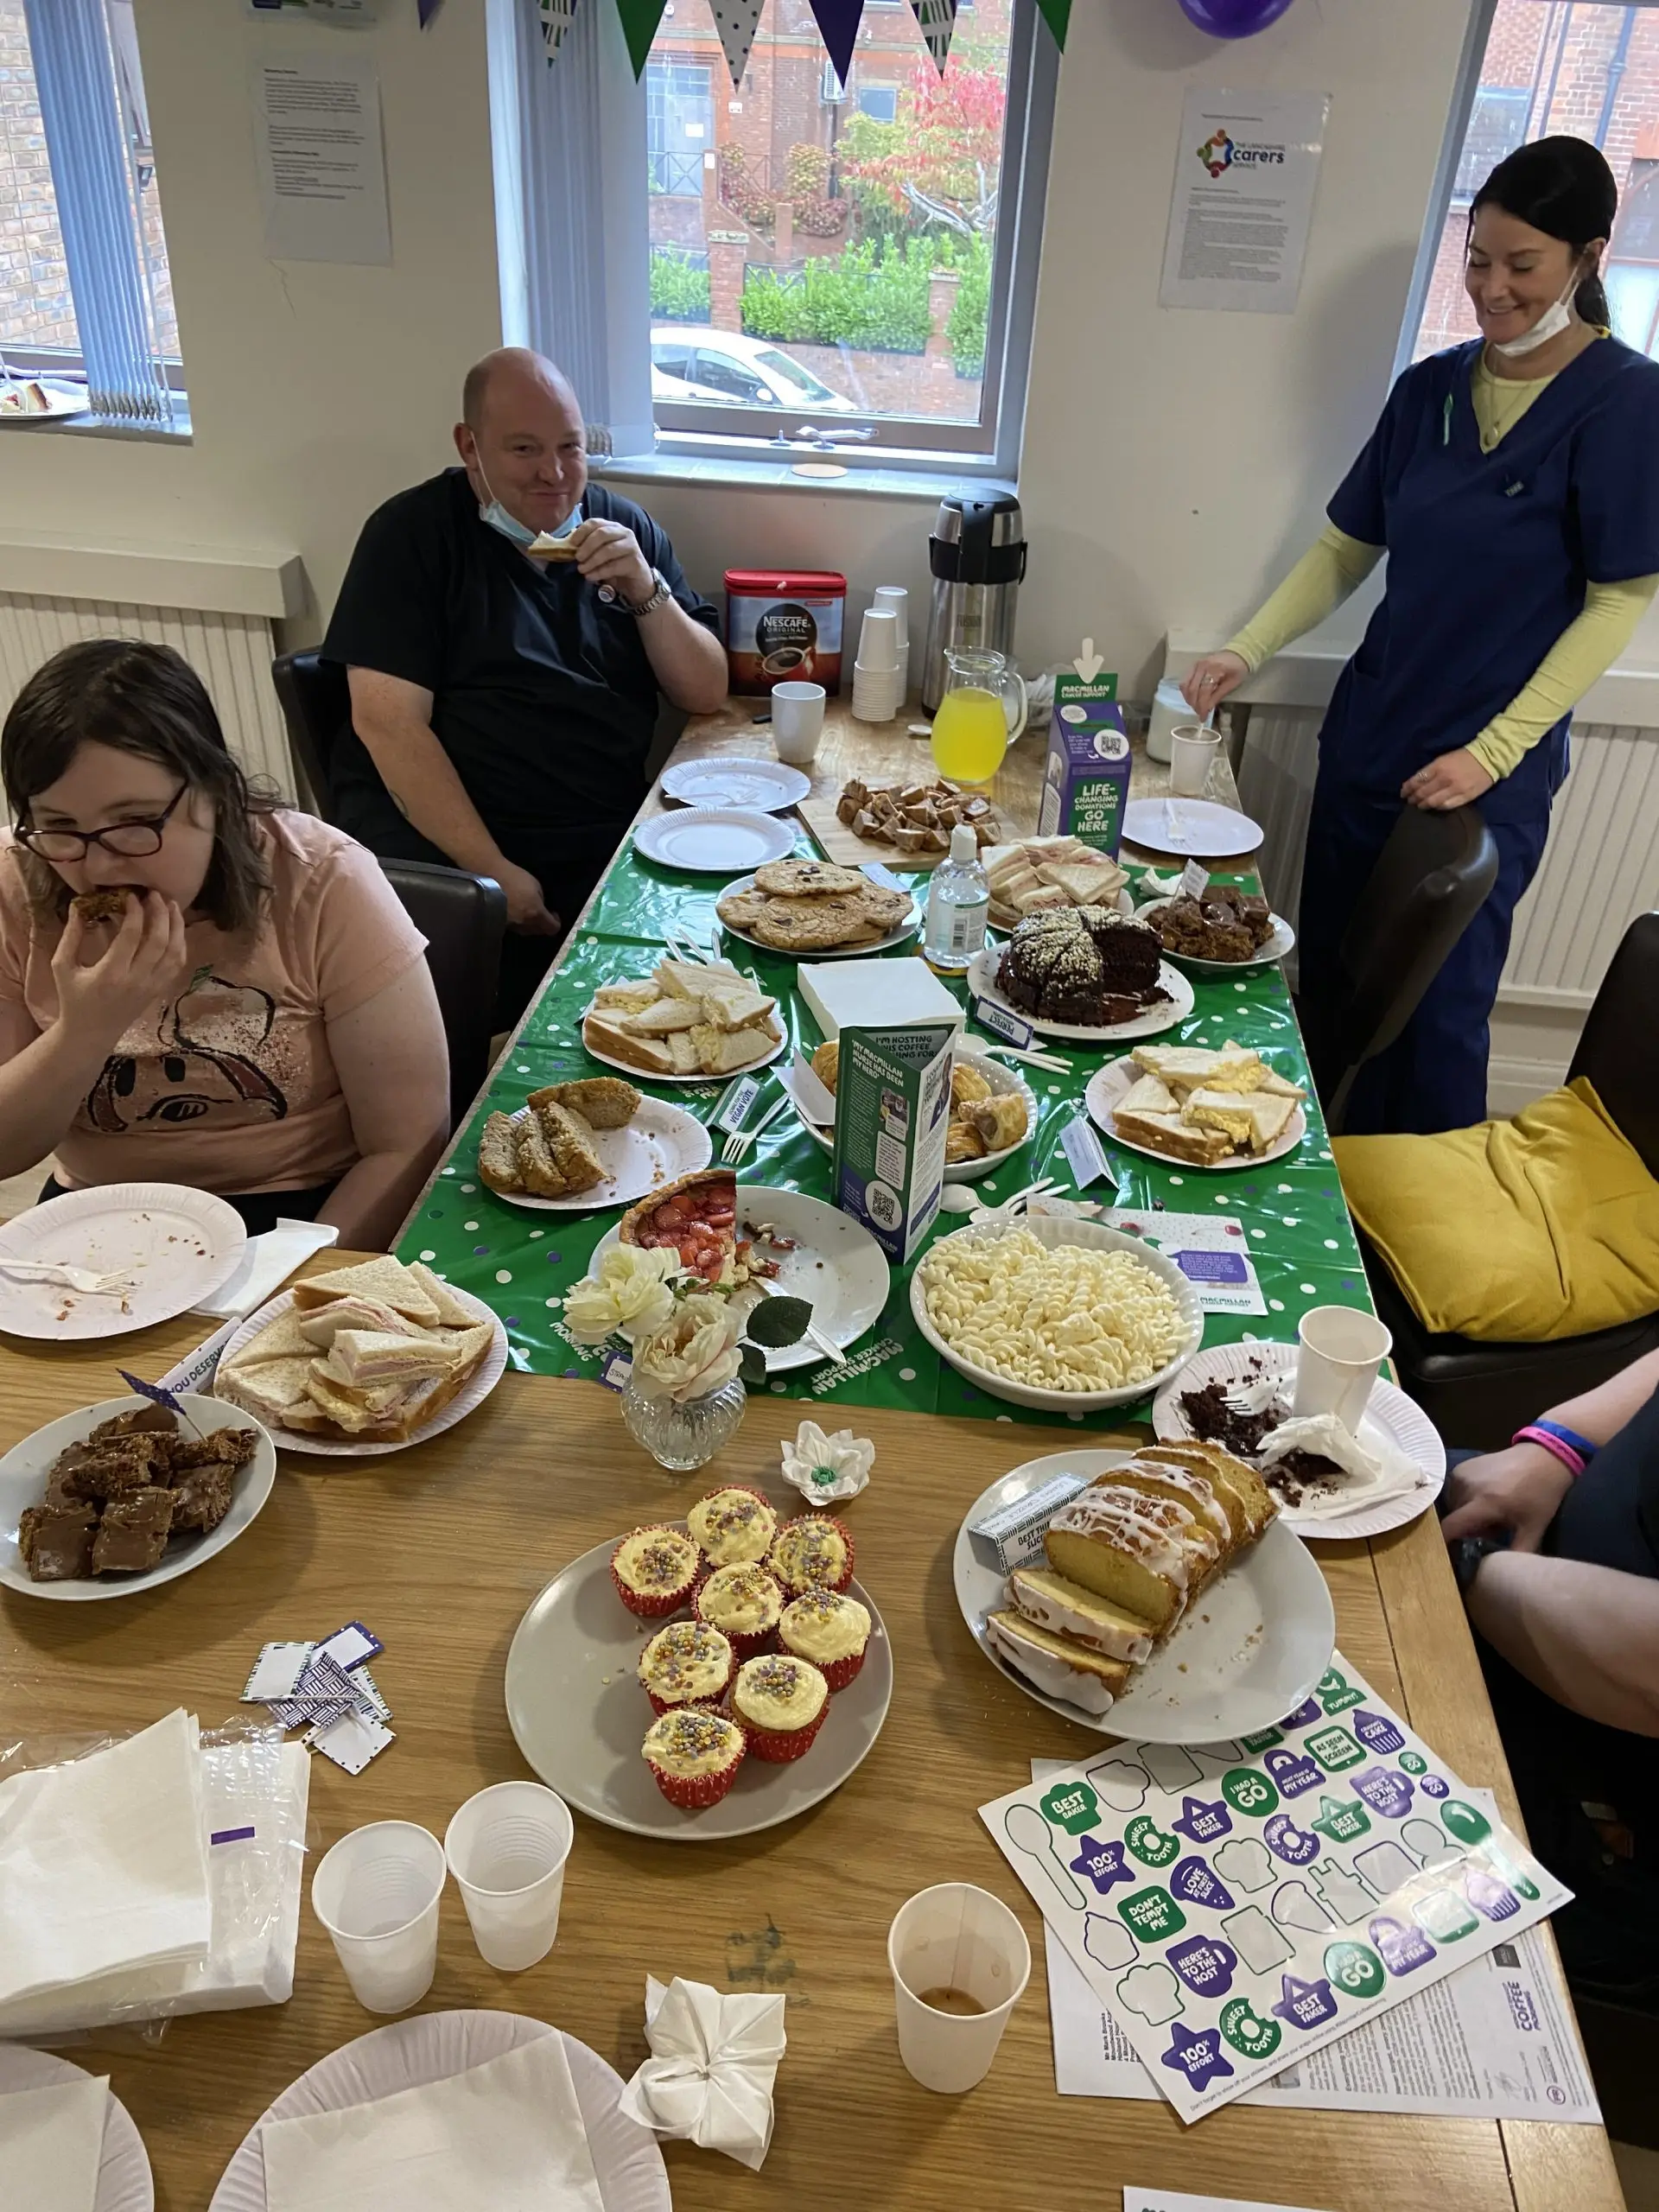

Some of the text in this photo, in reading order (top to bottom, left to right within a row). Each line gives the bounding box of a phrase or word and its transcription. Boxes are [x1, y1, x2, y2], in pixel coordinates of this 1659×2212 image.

[1233, 149, 1285, 163] carers
[1074, 795, 1118, 804] CHANGING
[1082, 784, 1116, 796] LIFE-
[1084, 810, 1103, 821] GO
[1077, 821, 1109, 832] HERE
[852, 1056, 862, 1068] MY
[853, 1050, 904, 1087] NURSE HAS BEEN
[863, 1046, 903, 1077] MACMILLAN
[729, 1088, 753, 1124] VEGAN VOTE
[1199, 1297, 1251, 1306] MACMILLAN
[550, 1322, 593, 1362] MORNING
[854, 1338, 893, 1361] CANCER
[812, 1343, 904, 1395] MACMILLAN
[1018, 1528, 1034, 1546] BEST
[1363, 1725, 1388, 1739] CAKE
[1316, 1735, 1344, 1752] AS SEEN
[1325, 1745, 1354, 1763] SCREEN
[1407, 1759, 1422, 1770] GO
[1236, 1780, 1249, 1794] HAD
[1283, 1772, 1319, 1794] MY YEAR
[1360, 1777, 1389, 1794] HERE'S
[1429, 1781, 1443, 1794] GO
[1051, 1790, 1084, 1815] BEST
[1237, 1784, 1268, 1808] GO
[1366, 1783, 1398, 1803] TO THE
[1376, 1794, 1400, 1808] HOST
[1063, 1804, 1087, 1820] BAKER
[1192, 1811, 1217, 1832] BEST
[1331, 1811, 1355, 1832] BEST
[1130, 1821, 1149, 1847] SWEET
[1270, 1821, 1287, 1845] SWEET
[1146, 1842, 1173, 1861] TOOTH
[1287, 1840, 1313, 1859] TOOTH
[1094, 1862, 1118, 1878] EFFORT
[1184, 1867, 1205, 1894] LOVE
[1198, 1873, 1210, 1892] FIRST
[1200, 1880, 1215, 1899] SLICE
[1128, 1894, 1162, 1916] DON'T
[1133, 1903, 1170, 1927] TEMPT
[1149, 1916, 1169, 1932] ME
[1178, 1947, 1210, 1969] HERE'S
[1405, 1944, 1428, 1963] YEAR
[1182, 1956, 1217, 1979] TO THE
[1192, 1967, 1218, 1986] HOST
[1341, 1960, 1374, 1987] GO
[1293, 1993, 1320, 2014] BEST
[1507, 1978, 1533, 2033] COFFEE
[1227, 2005, 1246, 2036] SWEET
[1244, 2028, 1274, 2052] TOOTH
[1188, 2053, 1215, 2073] EFFORT
